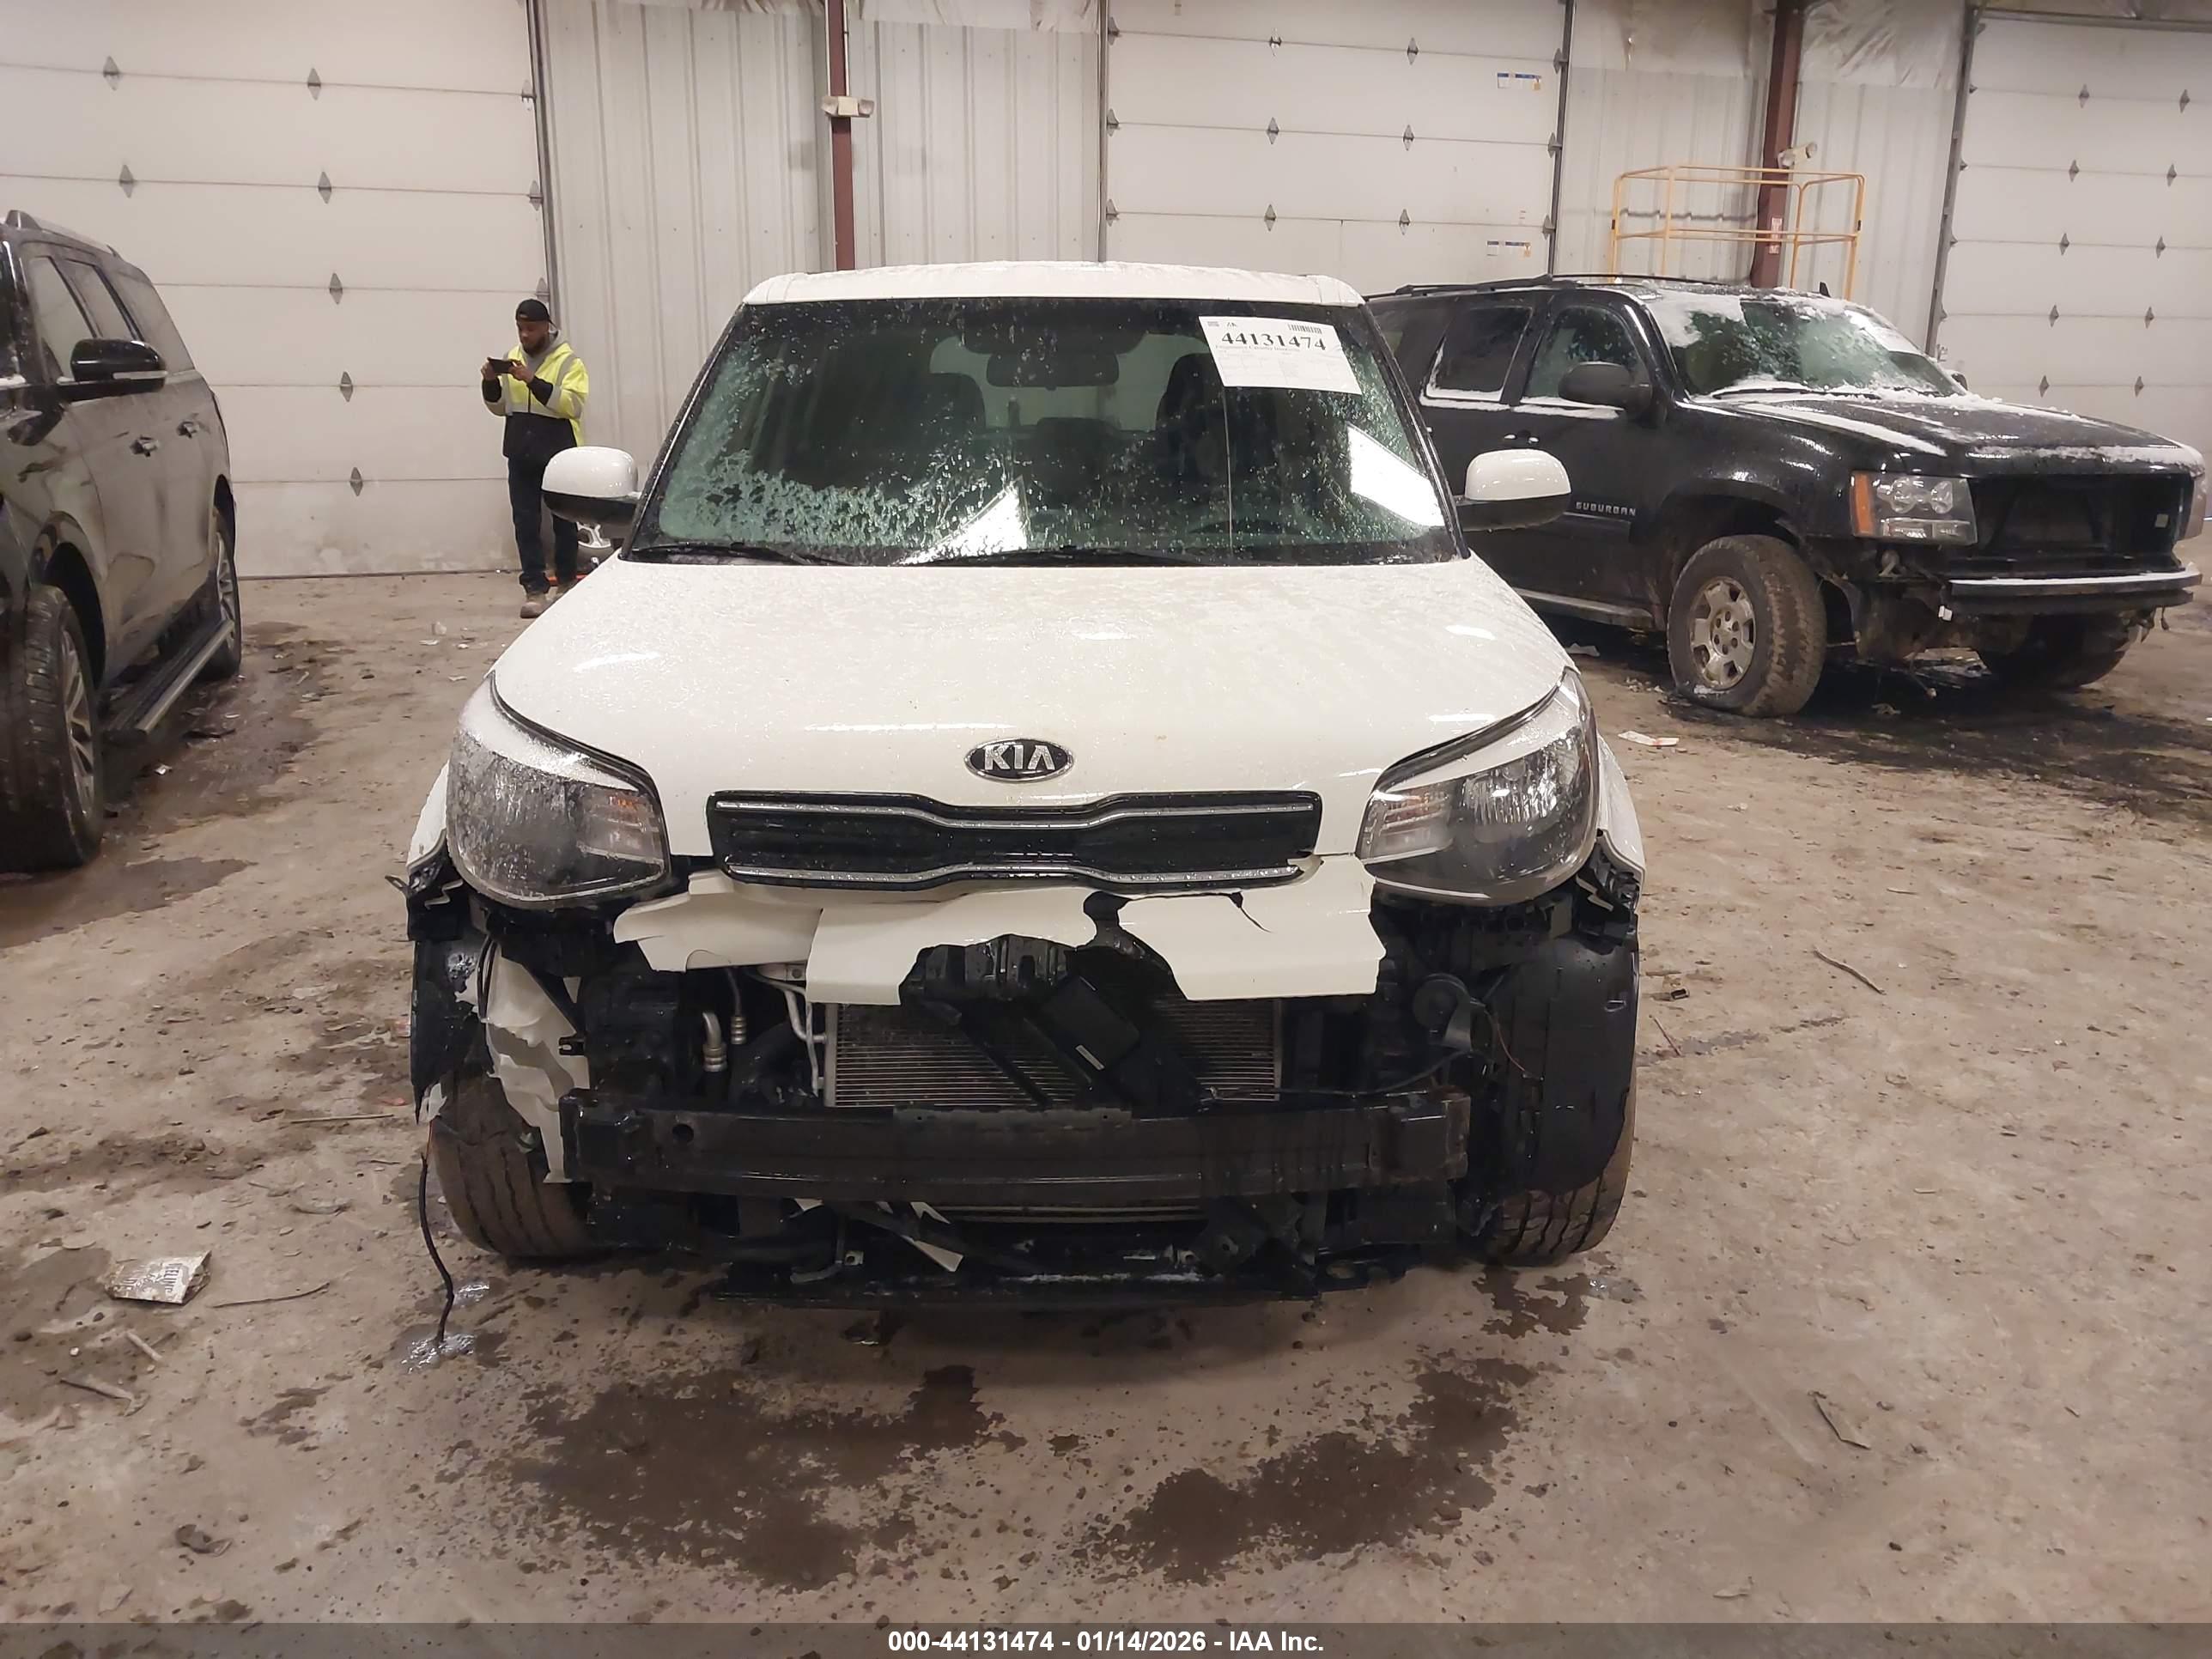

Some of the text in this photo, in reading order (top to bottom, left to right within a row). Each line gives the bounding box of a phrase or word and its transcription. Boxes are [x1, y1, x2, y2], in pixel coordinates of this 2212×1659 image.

[1221, 331, 1327, 350] 44131474
[1576, 501, 1636, 516] SUBURBAN
[983, 744, 1055, 770] KIA
